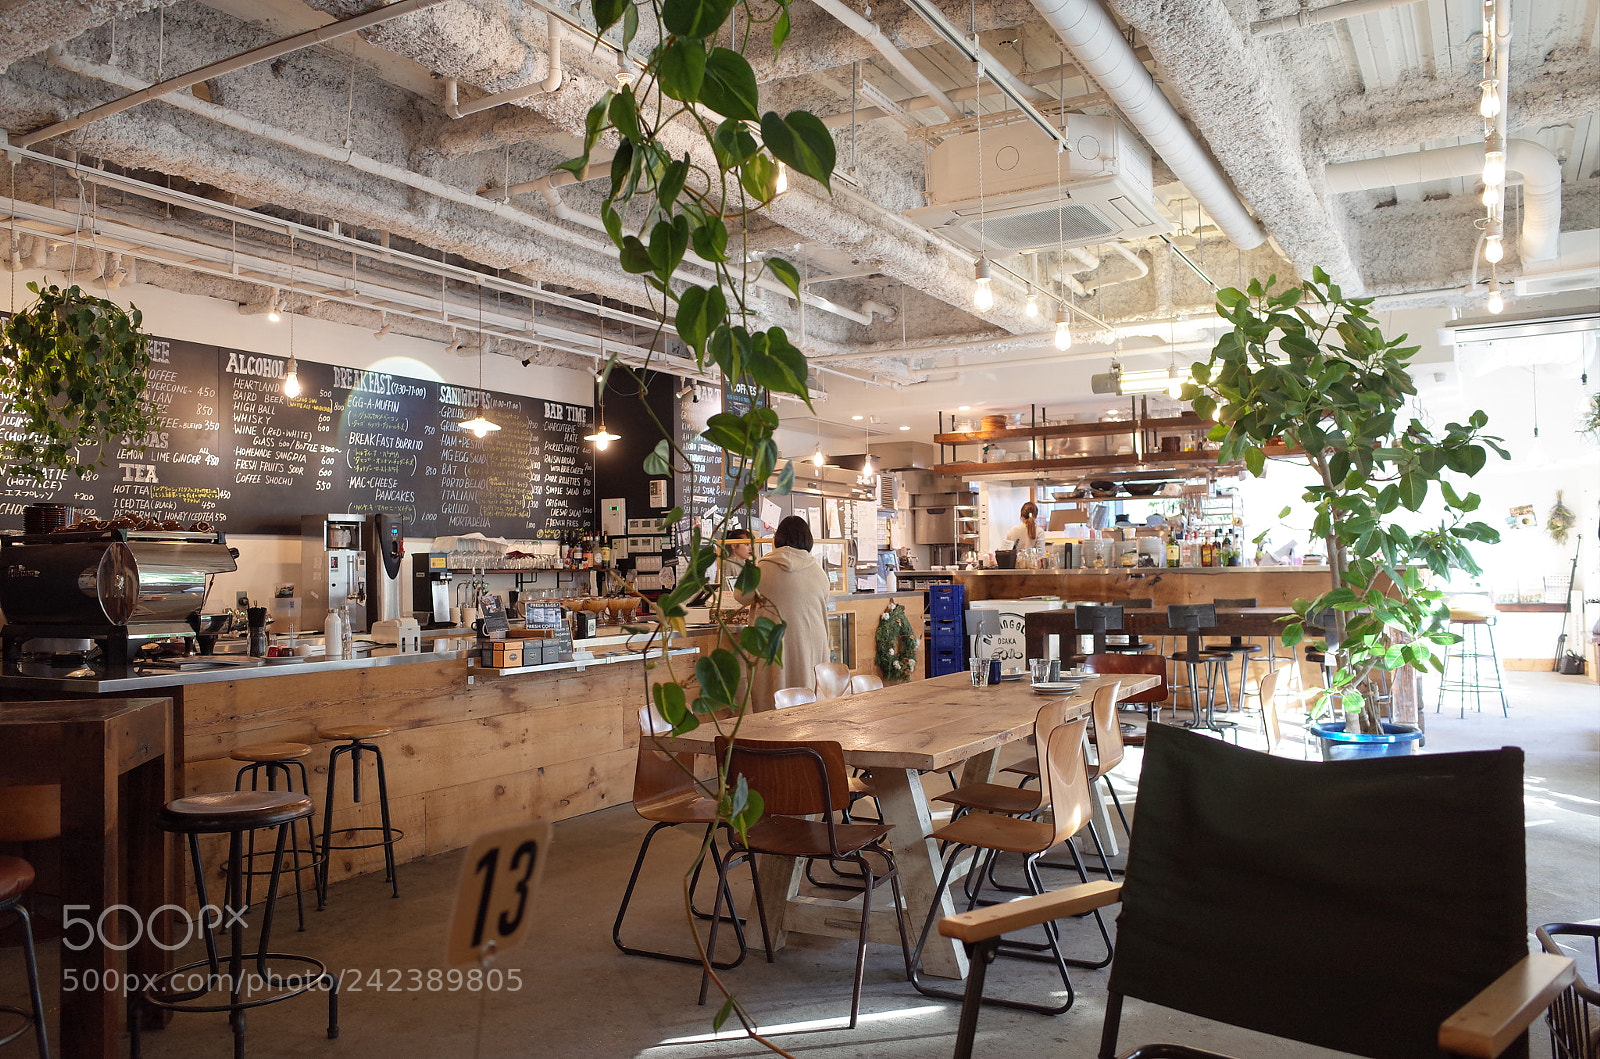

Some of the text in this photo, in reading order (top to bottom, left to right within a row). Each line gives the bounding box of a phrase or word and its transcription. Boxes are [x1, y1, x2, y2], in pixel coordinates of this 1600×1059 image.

[197, 386, 216, 398] 450
[233, 390, 257, 402] BAIRD
[264, 394, 285, 405] BEER
[196, 402, 213, 416] 850
[544, 402, 563, 420] BAR
[566, 405, 587, 423] TIME
[233, 413, 330, 432] WHISKY 600
[319, 413, 331, 422] 600
[204, 419, 220, 431] 350
[234, 424, 257, 436] WINE
[321, 456, 335, 465] 600
[118, 462, 159, 484] TEA
[318, 467, 333, 477] 600
[442, 463, 458, 476] BAT
[235, 472, 262, 484] COFFEE
[112, 484, 131, 494] HOT
[316, 480, 332, 491] 550
[374, 488, 415, 503] PANCAKES
[201, 501, 216, 510] 450
[471, 840, 538, 949] 13
